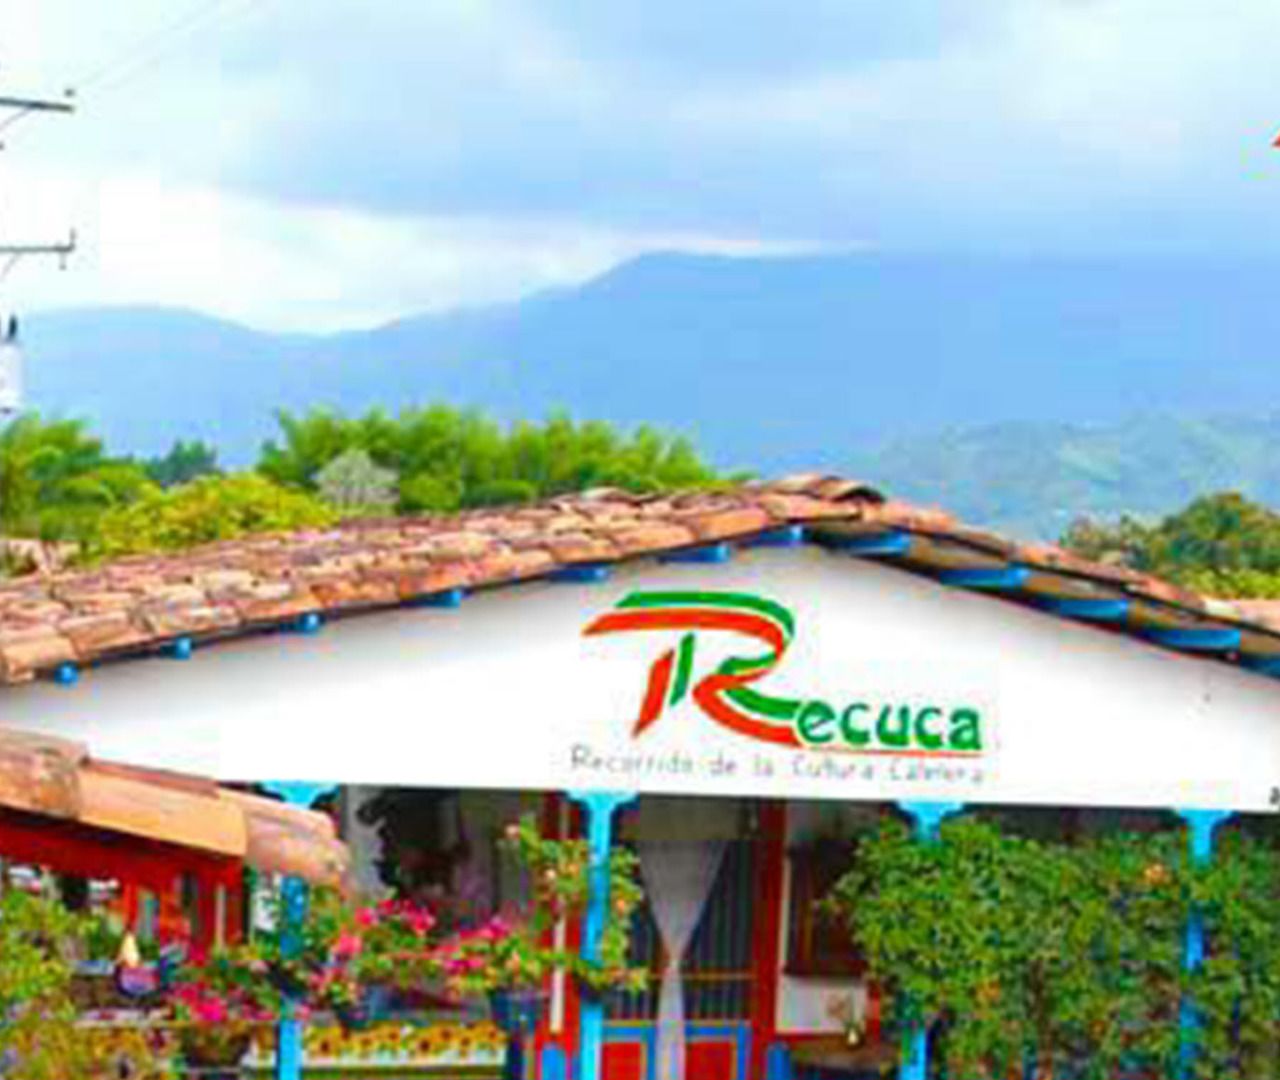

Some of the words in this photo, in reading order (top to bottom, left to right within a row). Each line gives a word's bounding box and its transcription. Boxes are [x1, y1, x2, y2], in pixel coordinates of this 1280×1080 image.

[581, 590, 984, 750] Recuca
[570, 743, 694, 774] Recorrido
[711, 748, 737, 776] de
[753, 753, 774, 777] la
